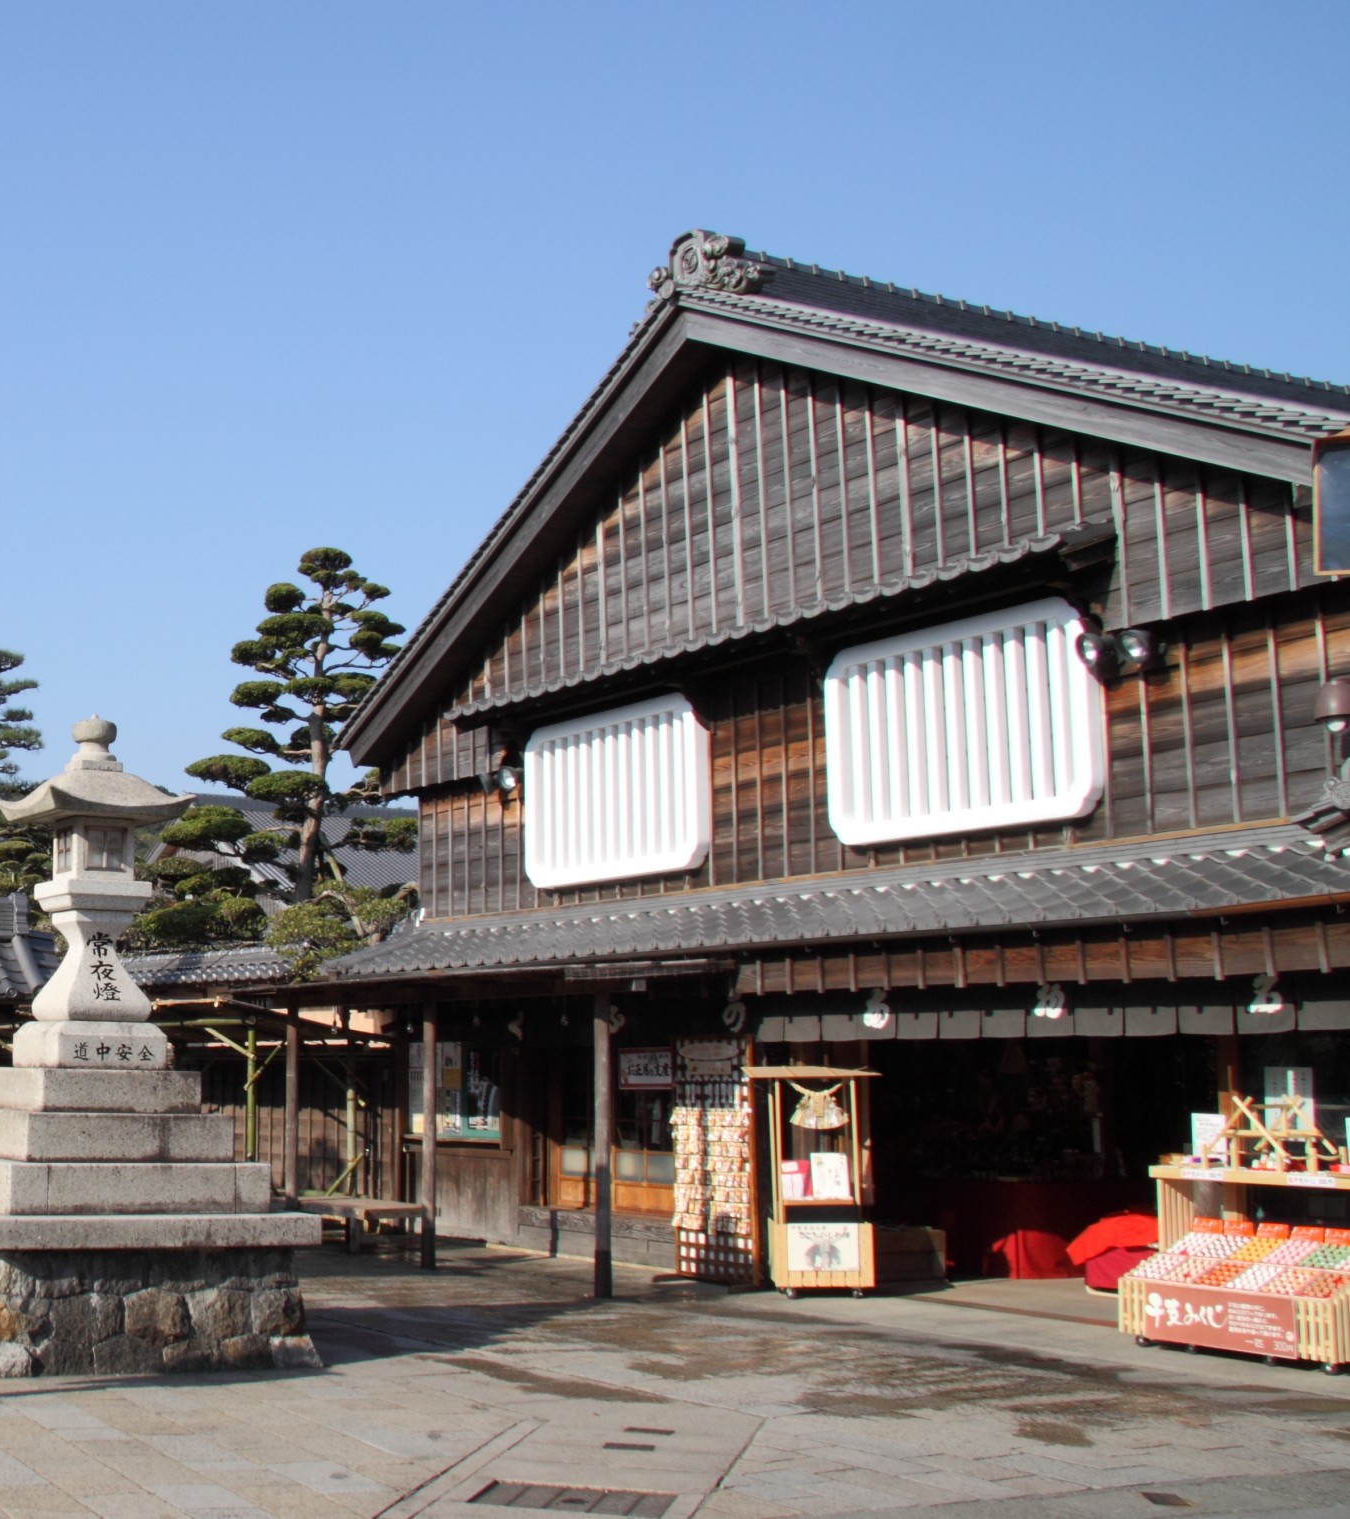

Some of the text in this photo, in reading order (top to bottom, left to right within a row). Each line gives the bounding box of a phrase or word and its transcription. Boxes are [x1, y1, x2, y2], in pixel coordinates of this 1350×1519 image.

[86, 931, 121, 1002] 常夜燈
[73, 1041, 156, 1062] 道中安全
